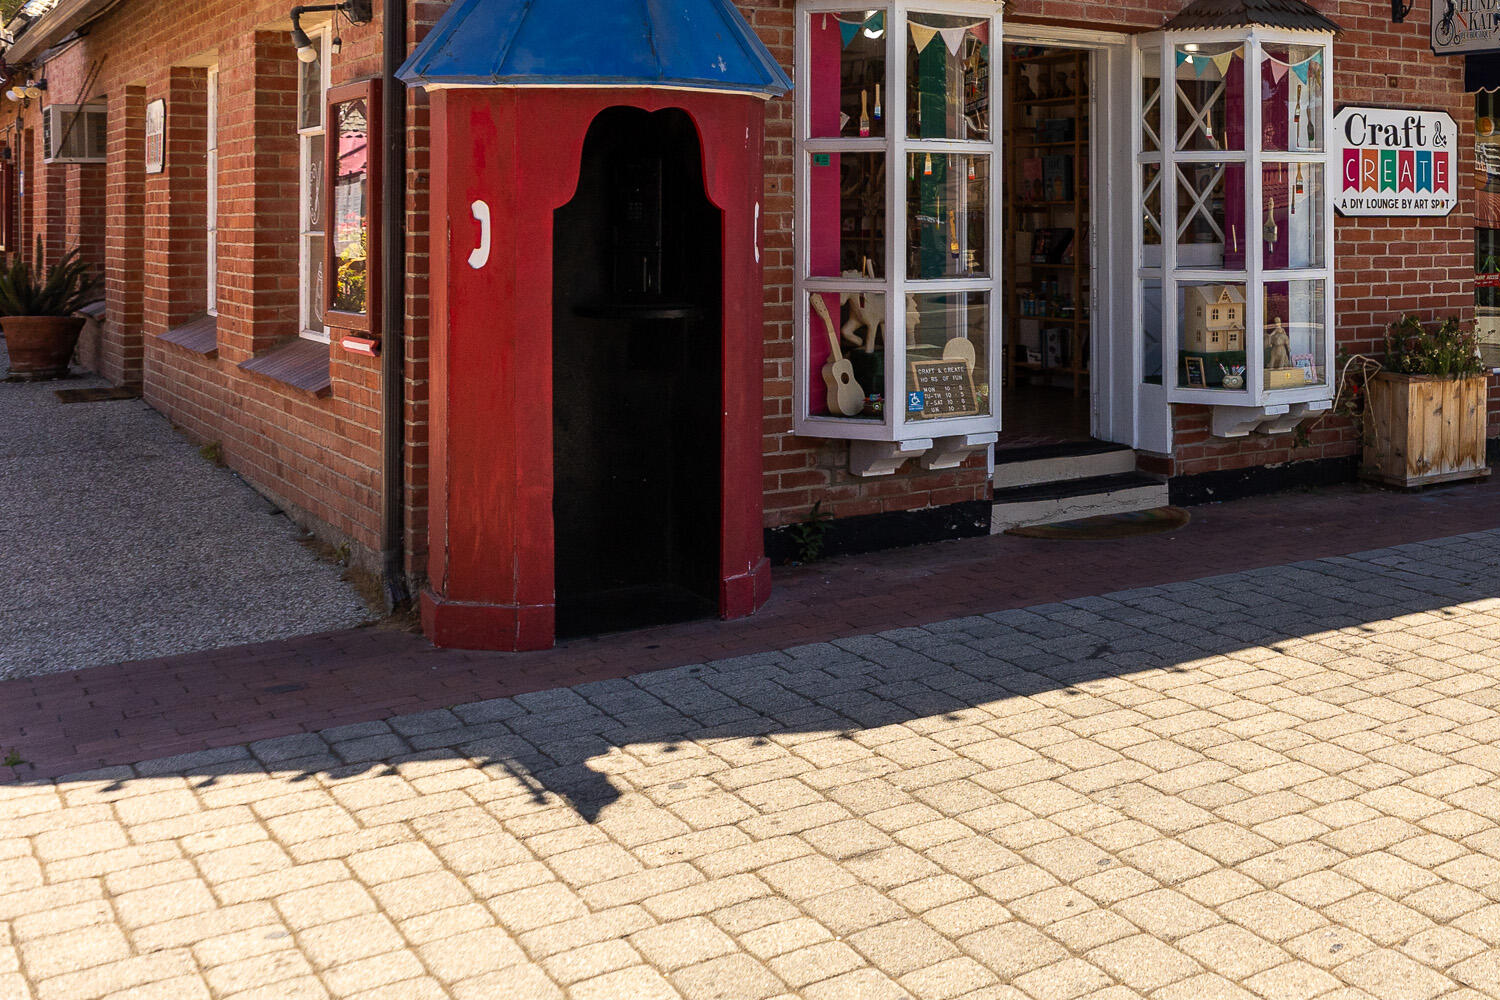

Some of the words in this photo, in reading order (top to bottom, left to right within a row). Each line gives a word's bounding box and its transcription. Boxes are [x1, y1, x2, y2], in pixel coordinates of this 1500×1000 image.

[1469, 12, 1494, 31] KAT
[1344, 113, 1427, 149] Craft
[1432, 120, 1447, 148] &
[1345, 158, 1446, 184] CREATE
[1341, 199, 1348, 209] A
[1350, 199, 1364, 209] DIY
[1366, 199, 1399, 209] LOUNGE
[1401, 199, 1412, 209] BY
[1414, 199, 1428, 209] ART
[1431, 199, 1450, 209] SPOT
